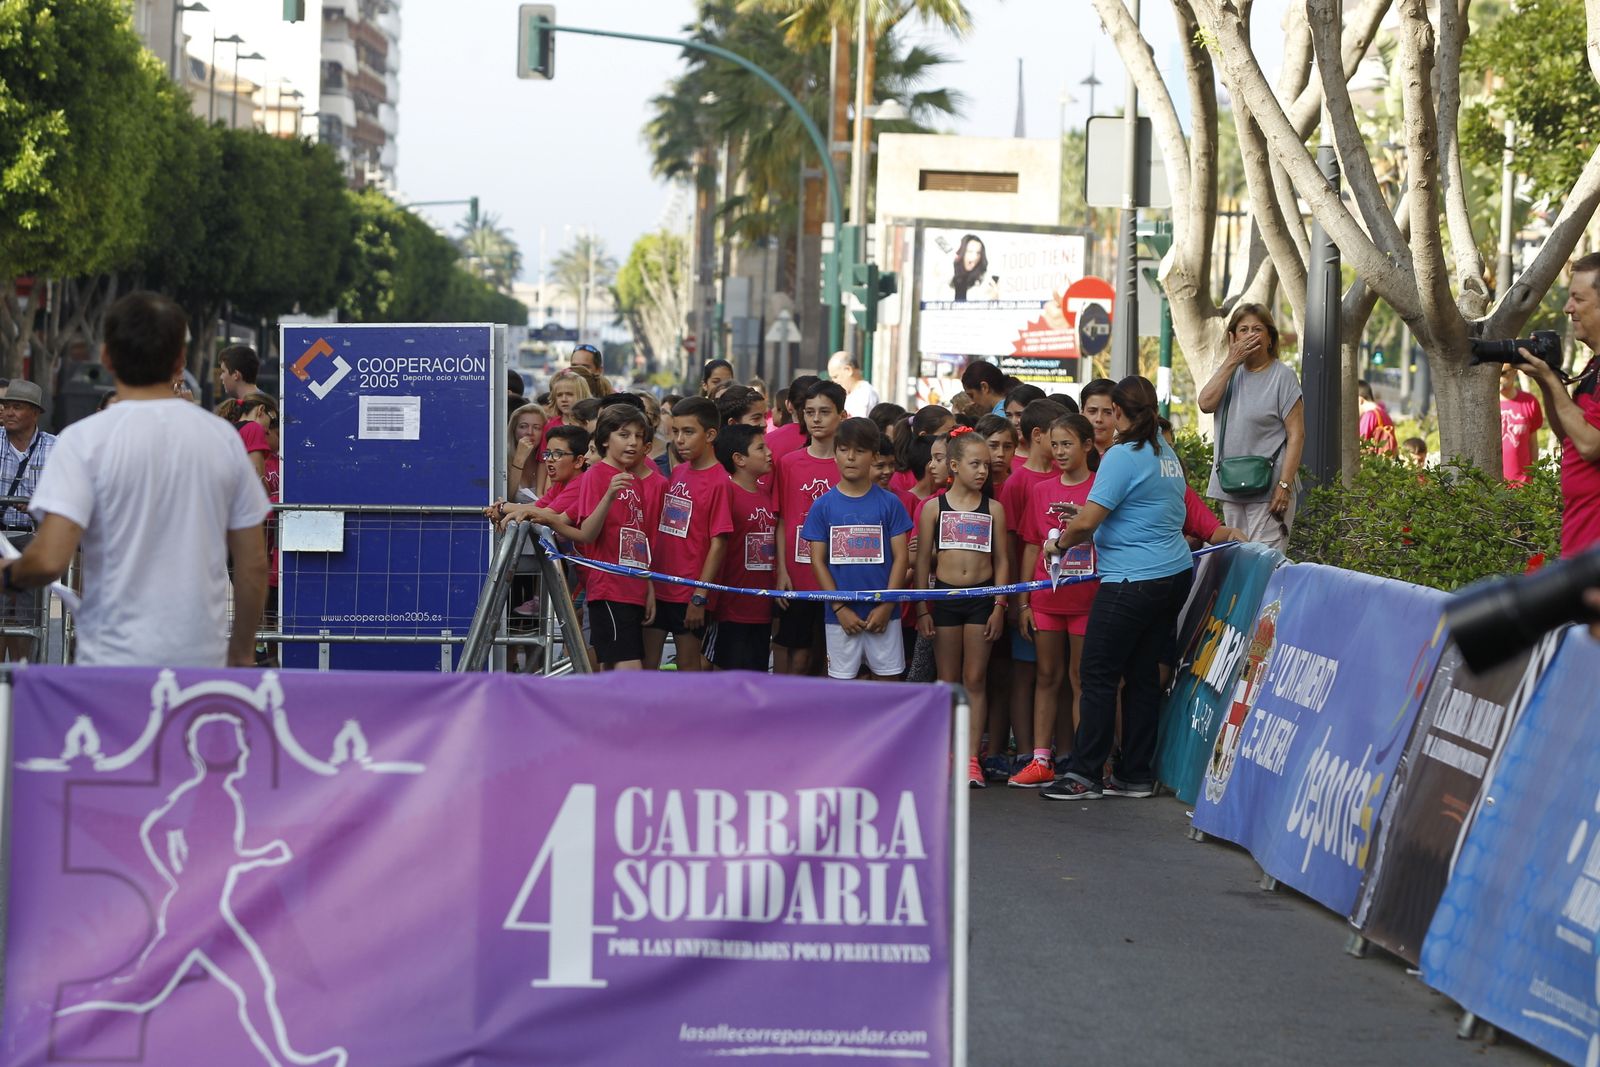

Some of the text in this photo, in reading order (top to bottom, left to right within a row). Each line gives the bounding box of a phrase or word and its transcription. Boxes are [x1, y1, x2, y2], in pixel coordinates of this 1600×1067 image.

[1002, 251, 1036, 269] TODO
[357, 354, 486, 373] COOPERACIÓN
[359, 374, 399, 388] 2005
[402, 374, 434, 382] Deporte,
[320, 611, 442, 623] www.cooperacion2005.es
[1286, 725, 1384, 873] deportes
[613, 786, 928, 859] CARRERA
[503, 783, 618, 988] 4
[612, 858, 928, 926] SOLIDARIA
[608, 938, 931, 964] POR LAS ENFERMEDADES POCO FRECUENTES
[678, 1023, 928, 1047] lasallecorreparaayudar.com
